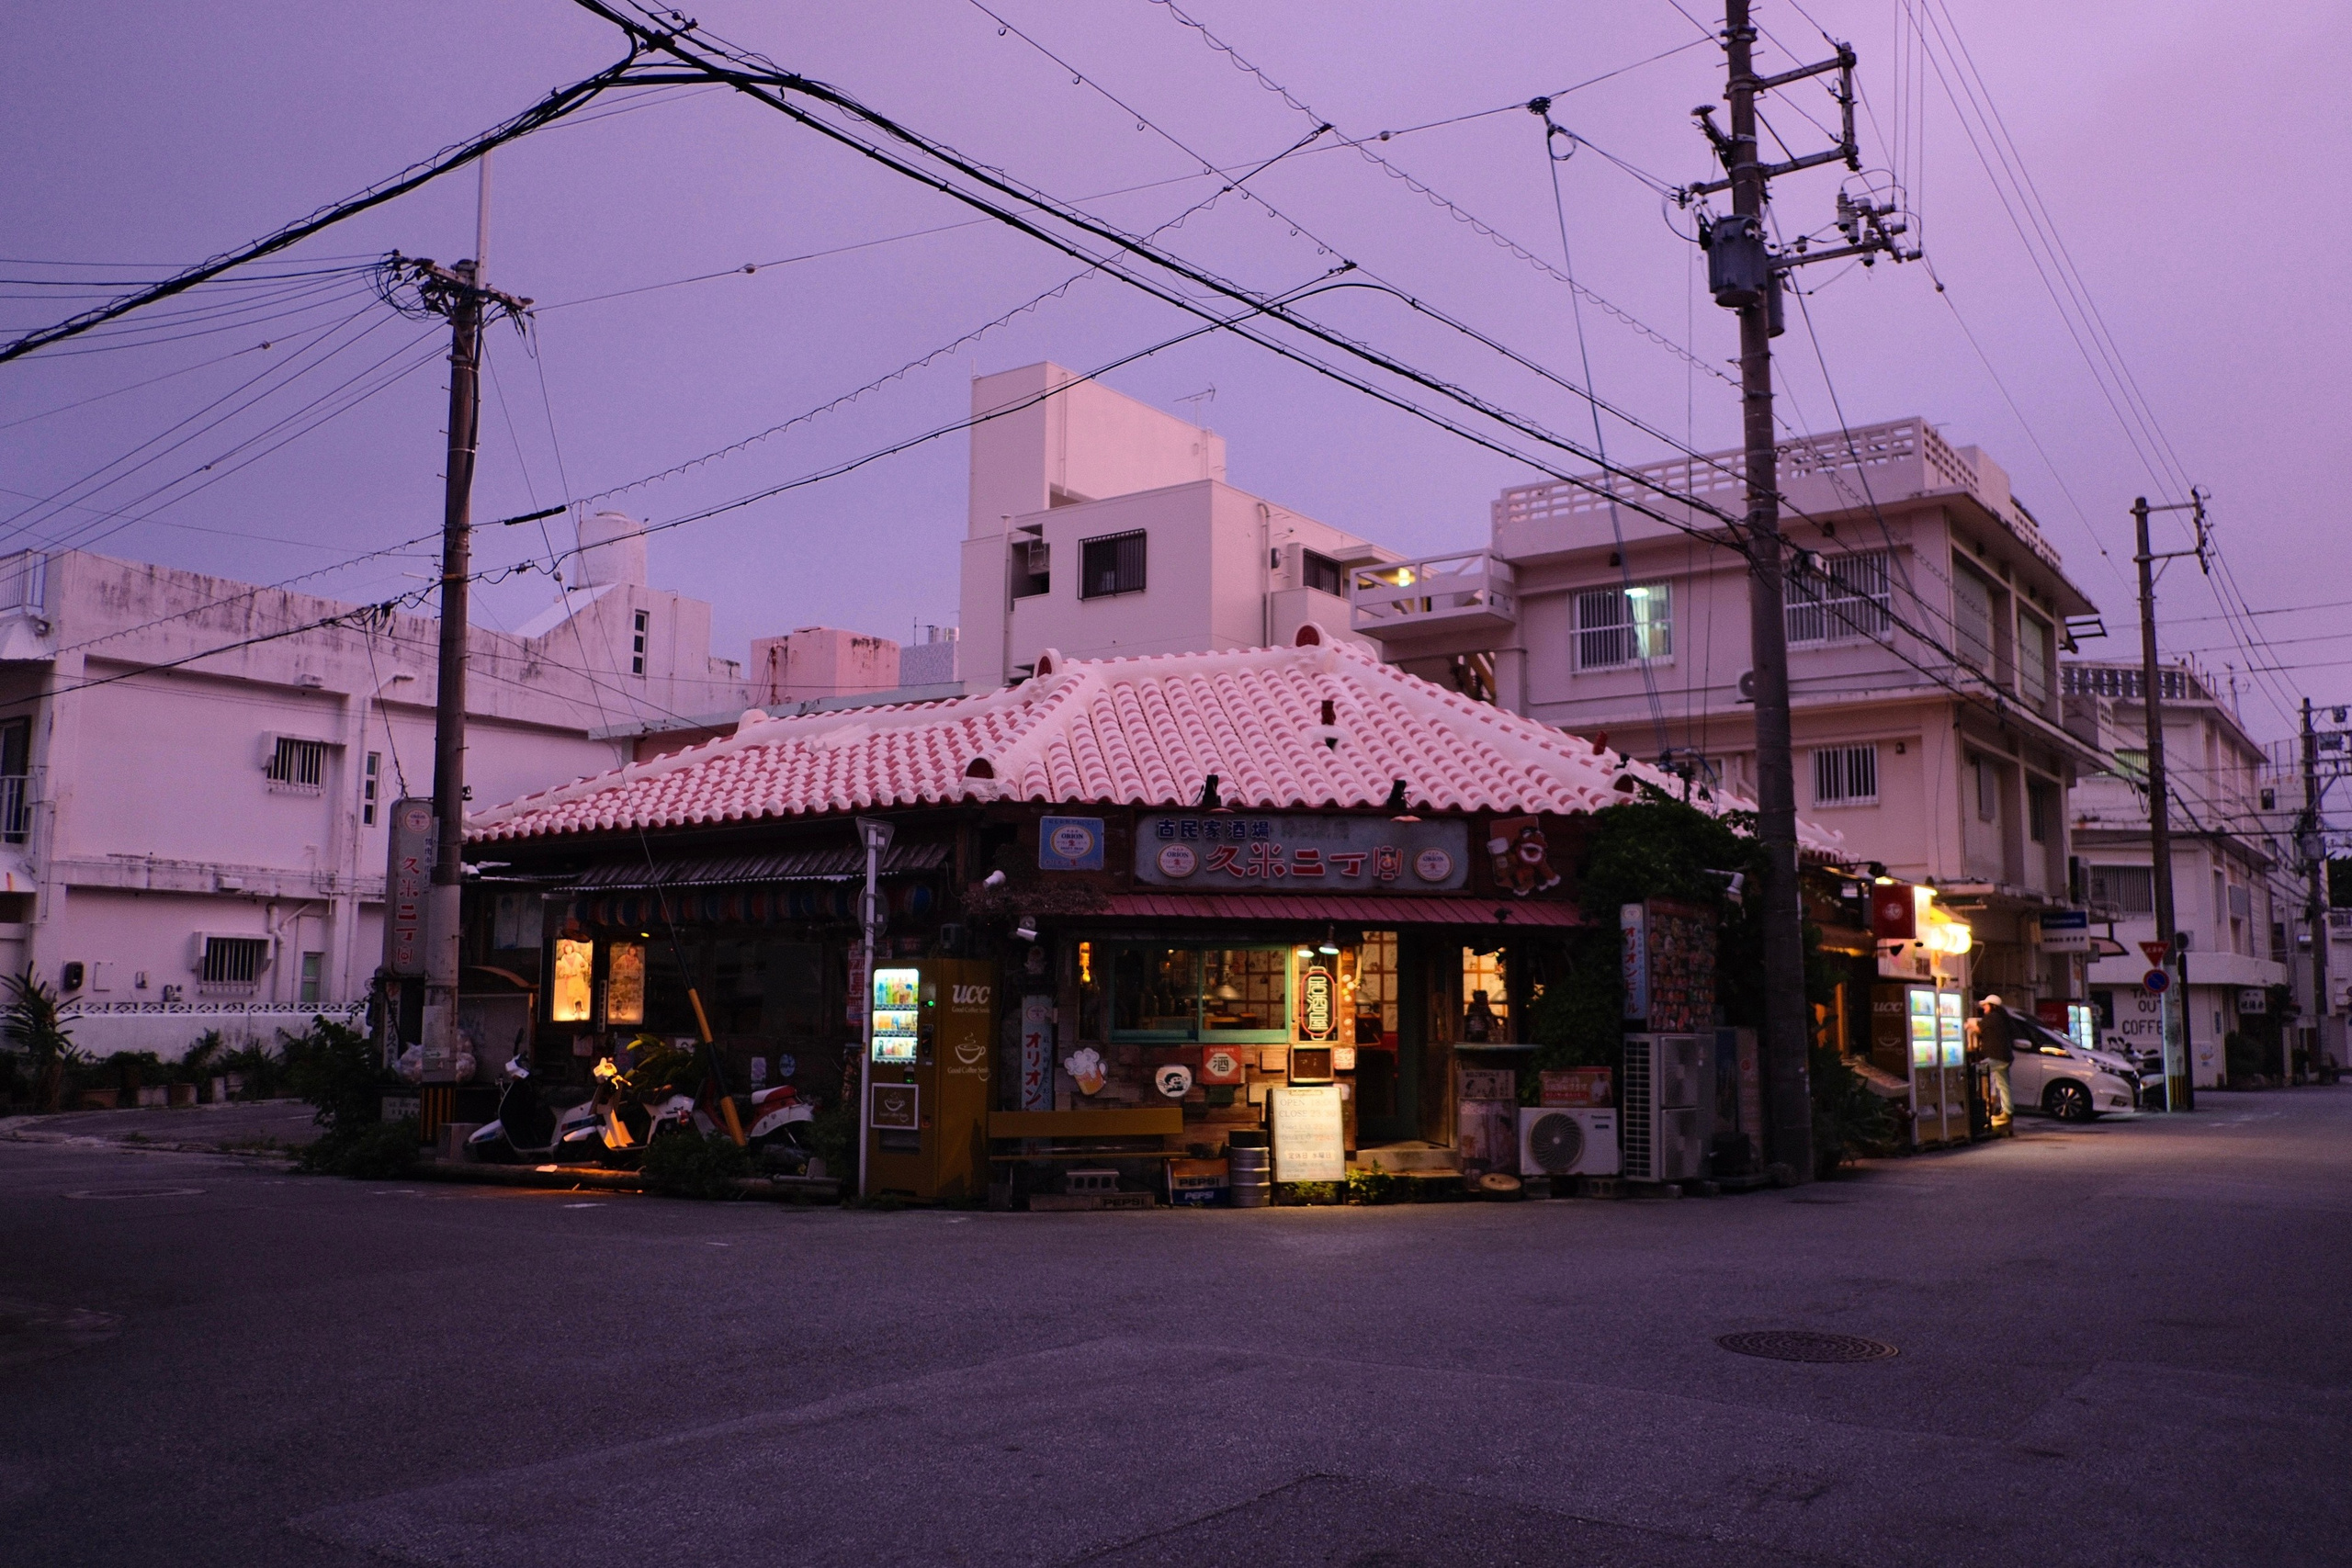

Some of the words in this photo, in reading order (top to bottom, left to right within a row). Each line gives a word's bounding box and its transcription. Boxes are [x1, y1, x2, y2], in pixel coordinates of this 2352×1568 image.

[1158, 818, 1271, 840] 古民家酒場
[1624, 926, 1639, 1014] オリオンビール
[1306, 976, 1329, 1031] 居酒屋
[2122, 1019, 2163, 1035] COFFE
[1213, 1055, 1229, 1072] 酒
[1280, 1098, 1306, 1107] OPEN
[1279, 1110, 1307, 1118] CLOSE
[1179, 1177, 1219, 1187] PEPSI
[1102, 1197, 1144, 1207] PEPSI
[1184, 1190, 1215, 1201] PEPSI
